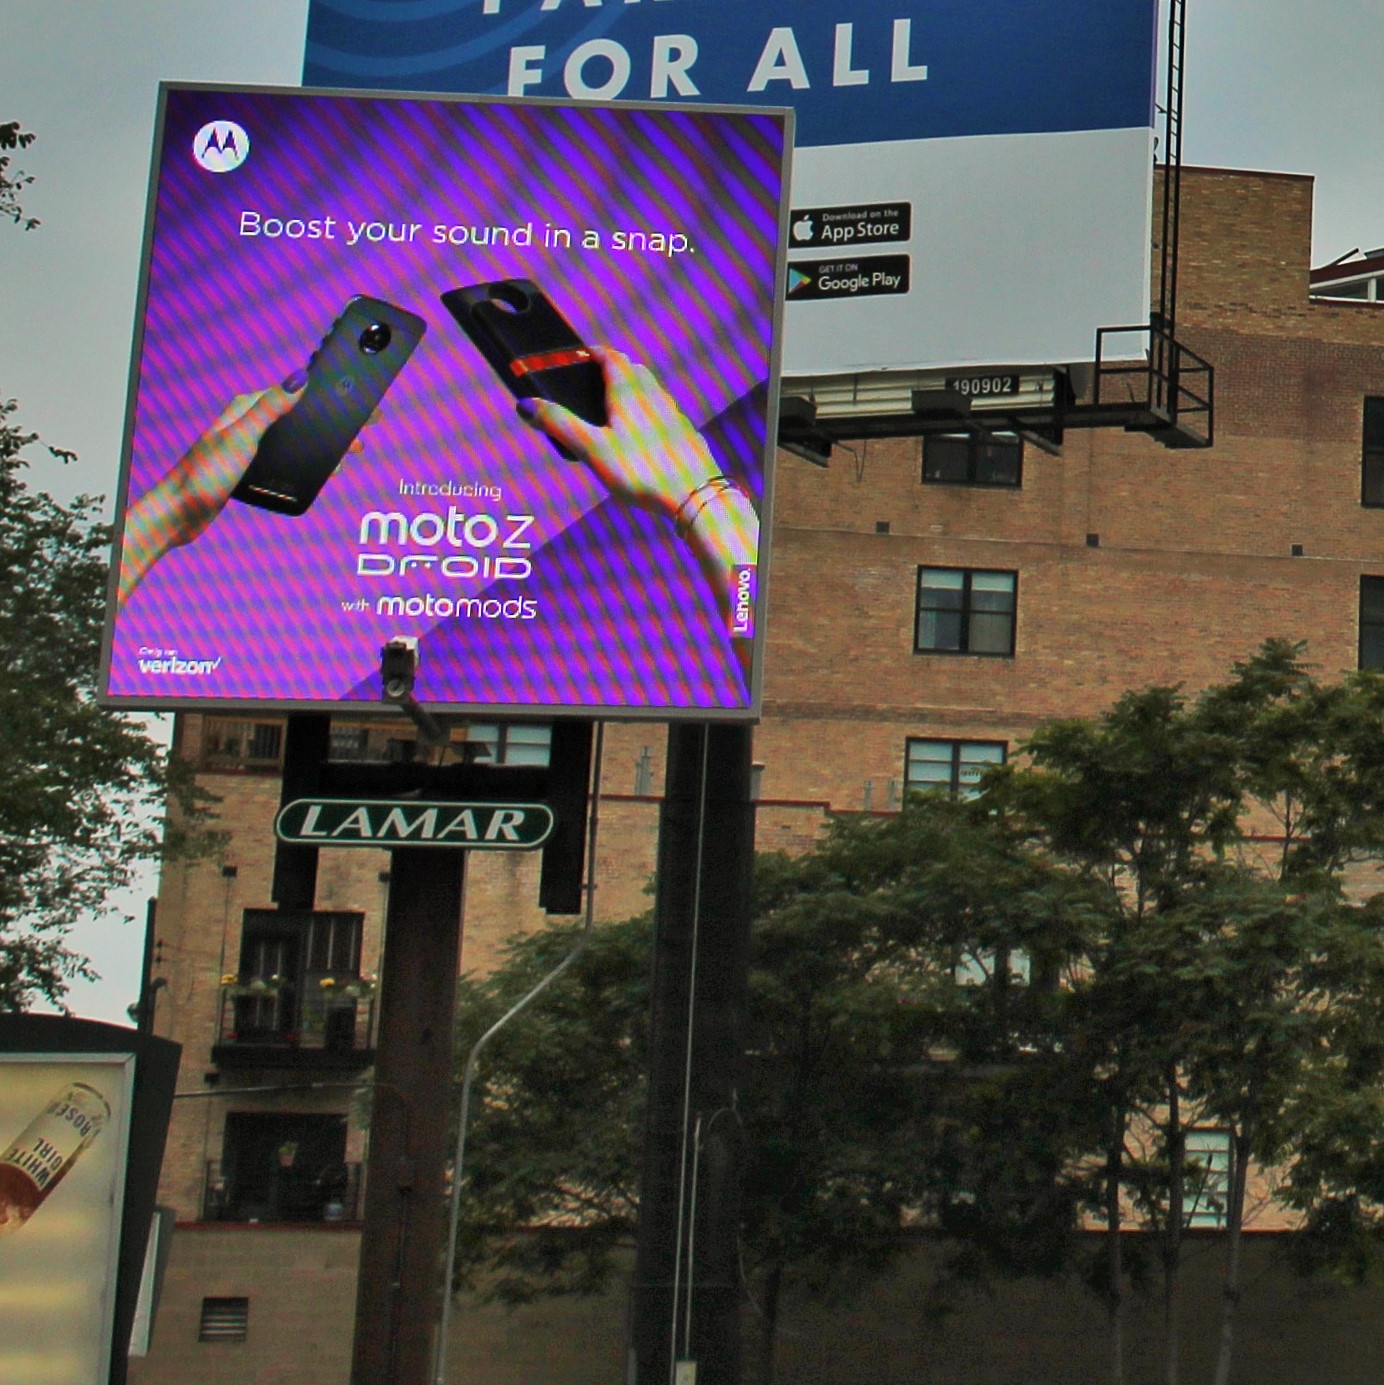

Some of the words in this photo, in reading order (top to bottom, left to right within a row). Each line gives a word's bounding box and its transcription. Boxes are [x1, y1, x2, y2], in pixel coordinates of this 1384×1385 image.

[507, 34, 701, 100] FOR
[747, 18, 928, 92] ALL
[822, 211, 867, 222] Download
[884, 209, 899, 217] the
[240, 211, 336, 238] Boost
[346, 221, 421, 245] your
[432, 222, 533, 246] sound
[545, 223, 571, 248] in
[582, 229, 600, 249] a
[611, 230, 695, 257] snap.
[821, 224, 854, 242] App
[857, 221, 900, 237] Store
[818, 274, 869, 292] Google
[872, 272, 901, 288] Play
[953, 377, 1012, 395] 190902
[399, 478, 502, 502] Introducing
[356, 553, 533, 579] DROID
[341, 598, 370, 613] with
[138, 656, 216, 675] verizon
[300, 804, 525, 841] LAMAR
[33, 1137, 63, 1171] GIRL
[6, 1147, 50, 1187] WHITE
